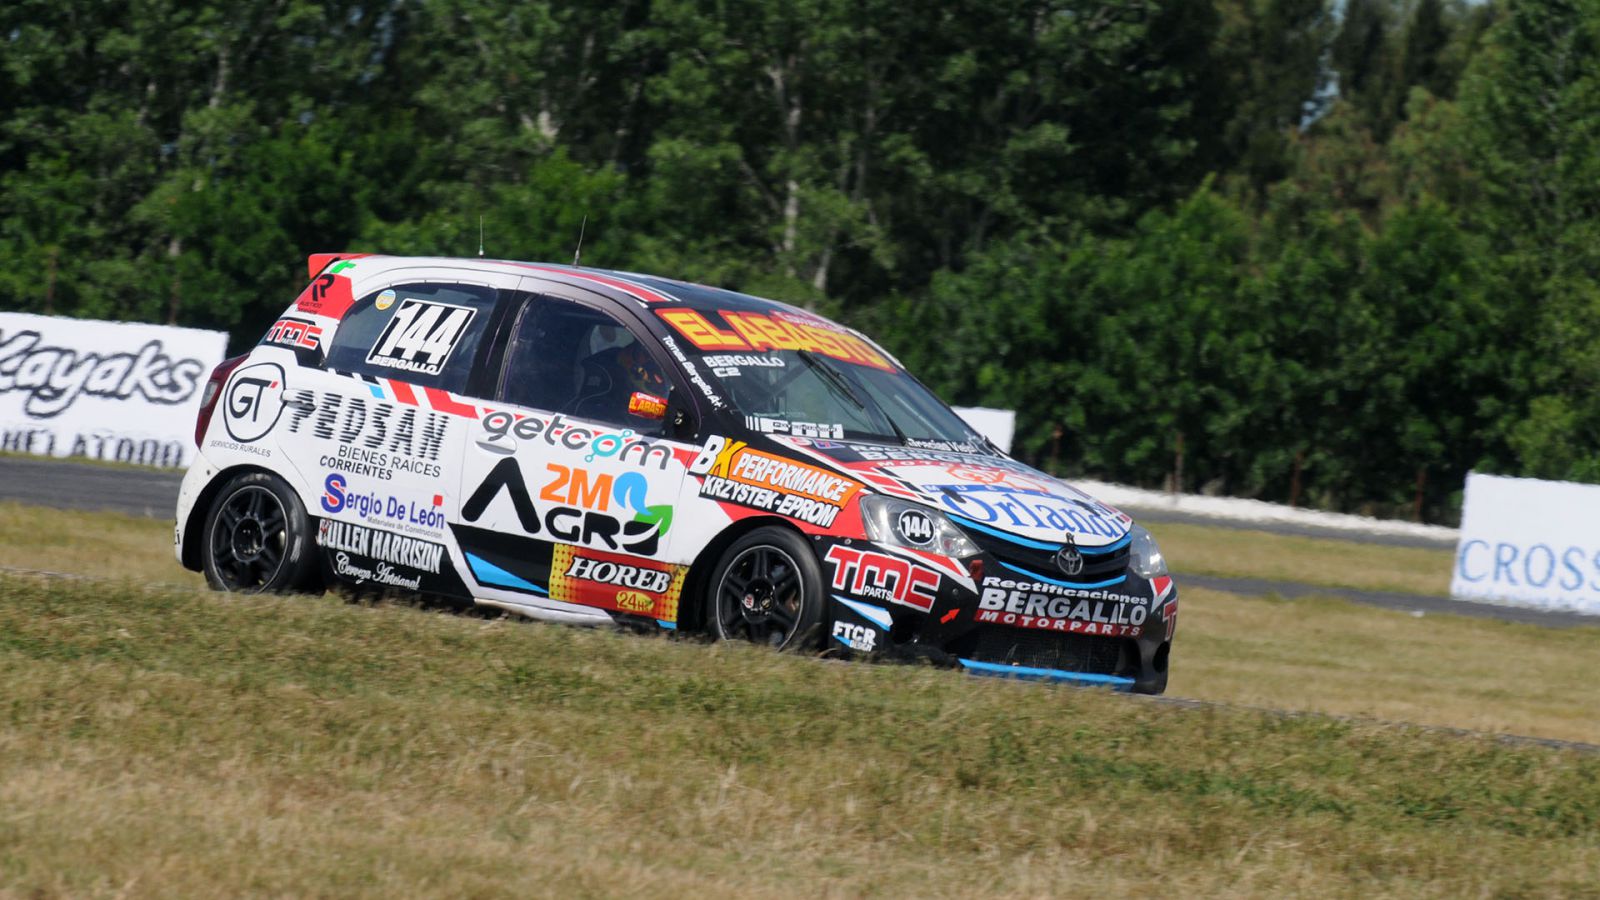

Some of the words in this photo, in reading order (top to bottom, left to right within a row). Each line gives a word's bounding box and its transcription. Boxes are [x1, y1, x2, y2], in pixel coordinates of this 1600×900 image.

[266, 321, 323, 350] TMC
[377, 302, 471, 365] 144
[372, 355, 439, 375] BERGALLO
[682, 361, 713, 396] Bergallo
[702, 355, 785, 368] BERGALLO
[229, 377, 272, 423] GT
[289, 389, 449, 461] PEDSAN
[482, 411, 671, 470] getcom
[210, 440, 239, 451] SERVICIOS
[239, 444, 272, 458] RURALES
[338, 444, 387, 467] BIENES
[390, 457, 441, 478] RAÍCES
[320, 455, 393, 481] CORRIENTES
[732, 452, 854, 502] PERFORMANCE
[321, 473, 382, 518] Sergio
[386, 496, 406, 520] De
[410, 501, 445, 530] León
[540, 463, 614, 512] 2M
[902, 516, 931, 538] 144
[370, 530, 444, 575] HARRISON
[566, 556, 671, 594] HOREB
[825, 545, 941, 613] TMC
[982, 577, 1148, 604] Rectificaciones
[863, 585, 893, 601] PARTS
[979, 588, 1147, 626] BERGALLO
[832, 620, 876, 645] FTCR
[980, 612, 1140, 636] MOTORPARTS
